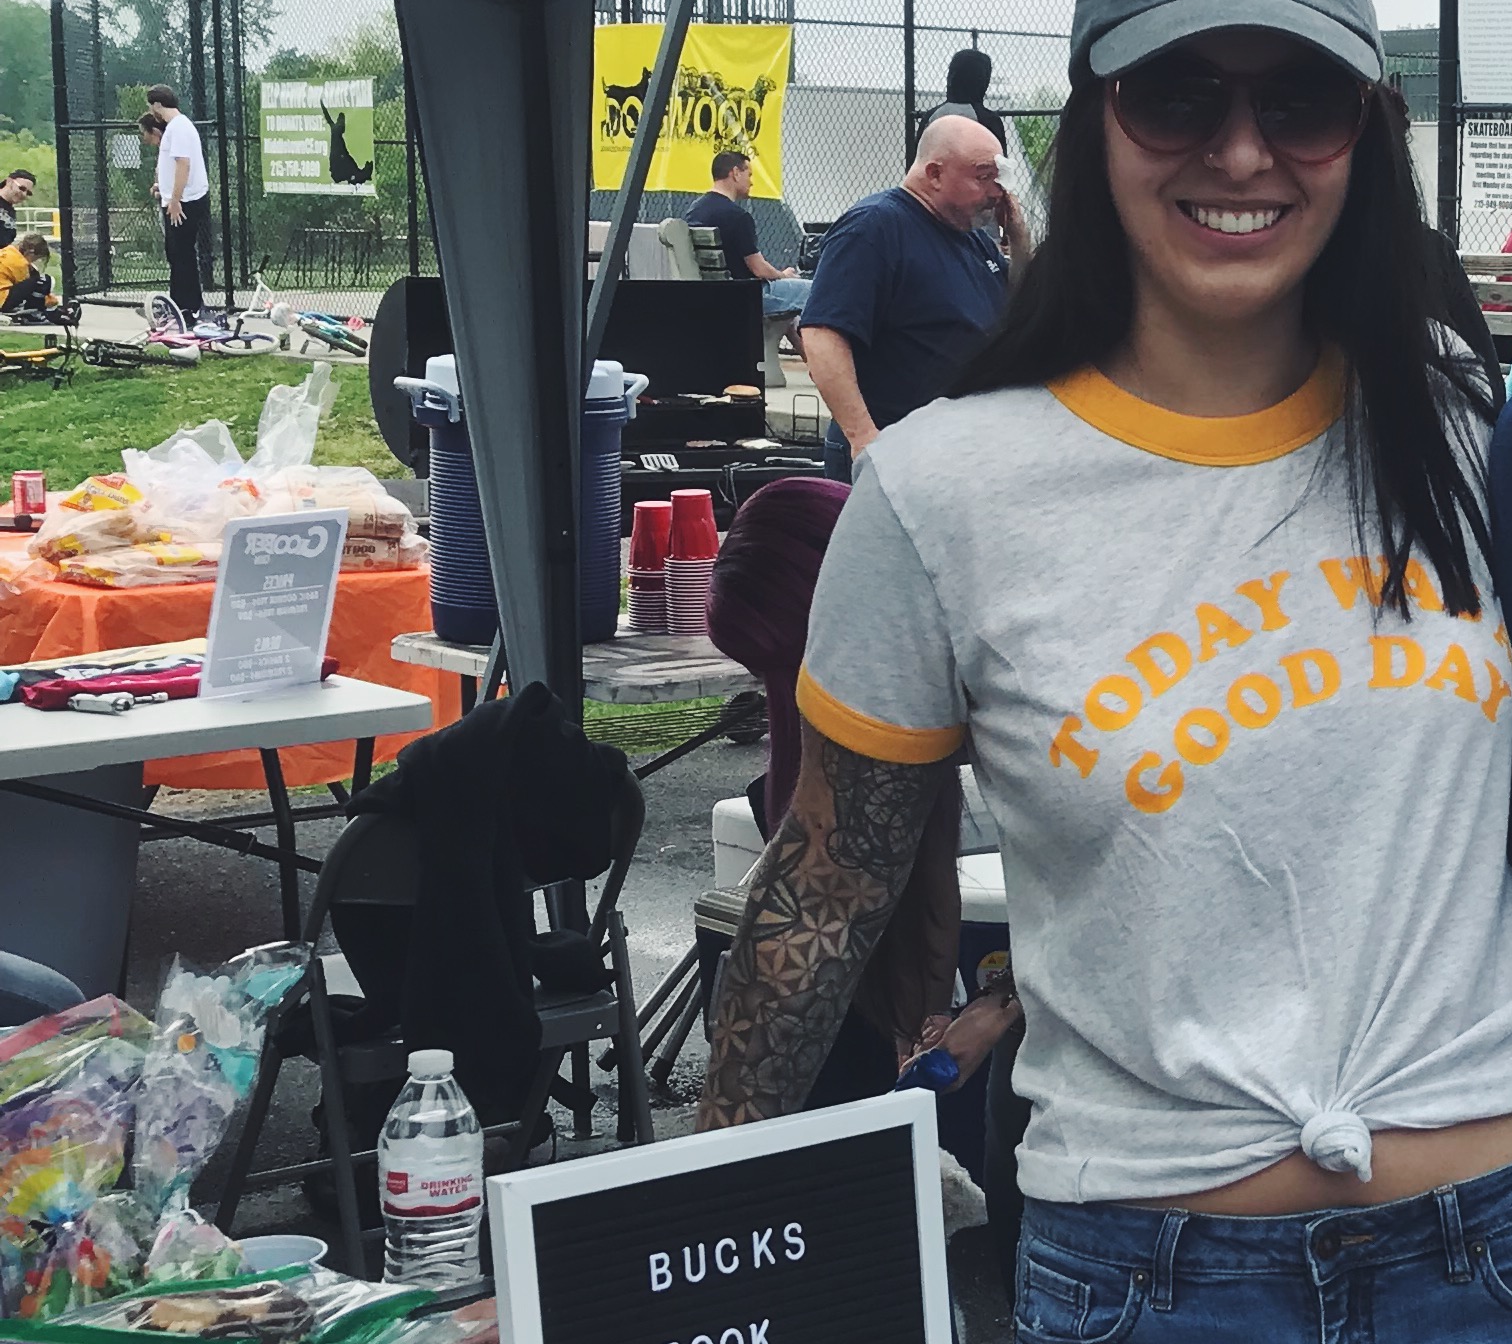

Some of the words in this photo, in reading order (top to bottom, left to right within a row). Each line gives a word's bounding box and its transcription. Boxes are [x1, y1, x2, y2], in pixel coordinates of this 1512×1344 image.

[604, 95, 762, 142] DOWOOD
[1049, 570, 1292, 779] TODAY
[1318, 554, 1483, 622] WA
[1125, 649, 1341, 814] GOOD
[1368, 635, 1512, 723] DAY
[421, 1173, 473, 1190] DRINKING
[429, 1184, 468, 1197] WATER
[649, 1222, 806, 1292] BUCKS
